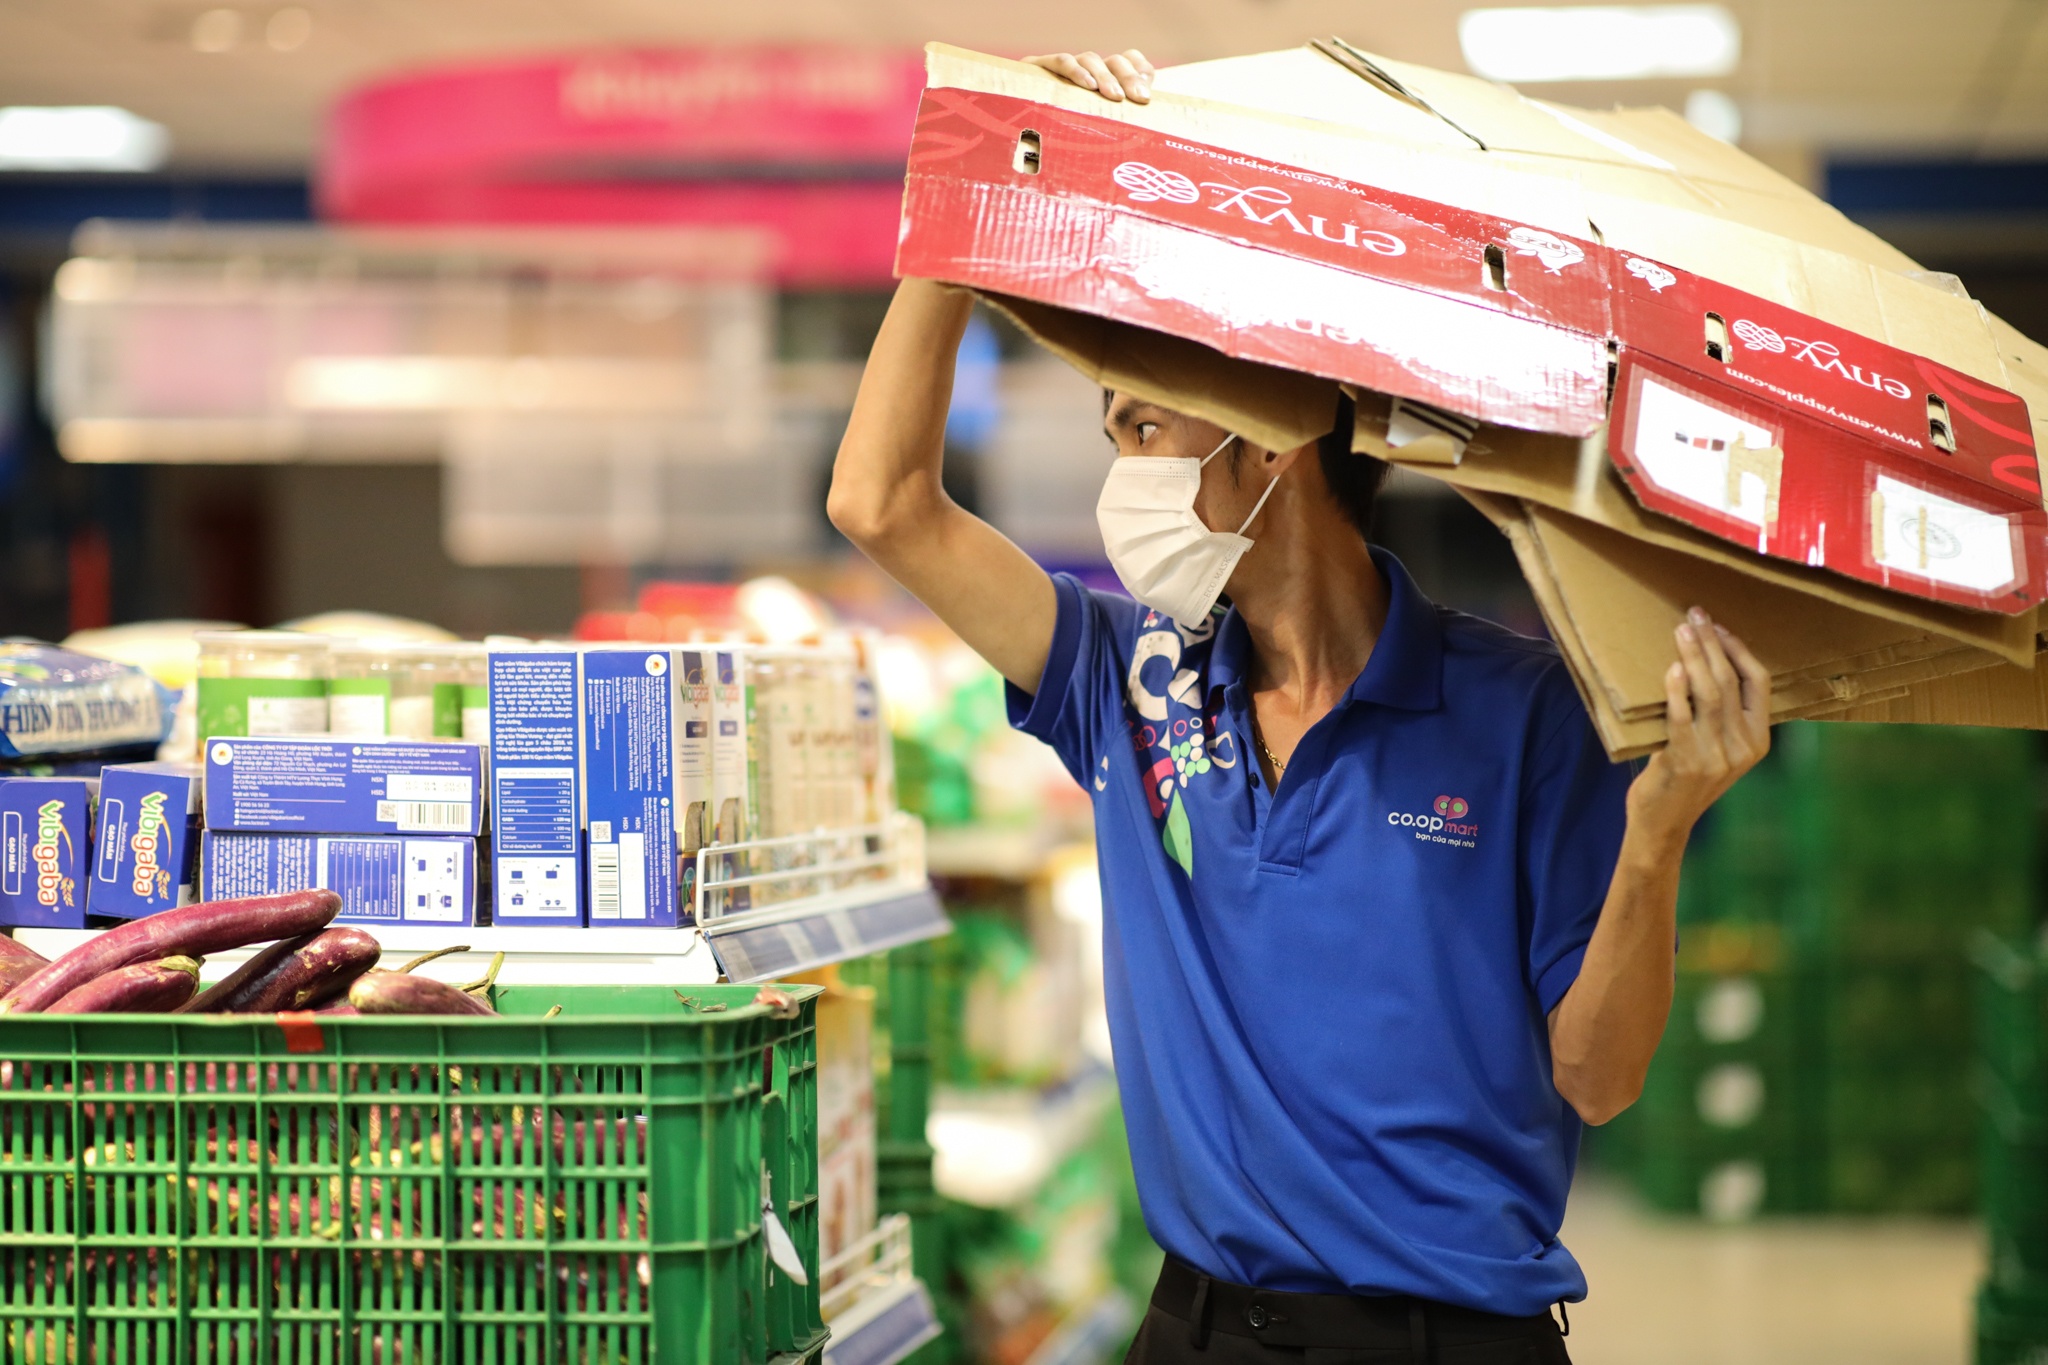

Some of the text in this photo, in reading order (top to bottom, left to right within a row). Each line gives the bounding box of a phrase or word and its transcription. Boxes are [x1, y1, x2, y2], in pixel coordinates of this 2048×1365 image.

[1165, 139, 1366, 197] www.envyapples.com
[1199, 182, 1407, 257] envy
[1784, 336, 1912, 400] envy
[1725, 367, 1923, 449] www.envyapples.com
[8, 837, 16, 853] GẠO
[107, 824, 115, 840] GẠO
[1416, 832, 1475, 848] bạn của mọi nhà
